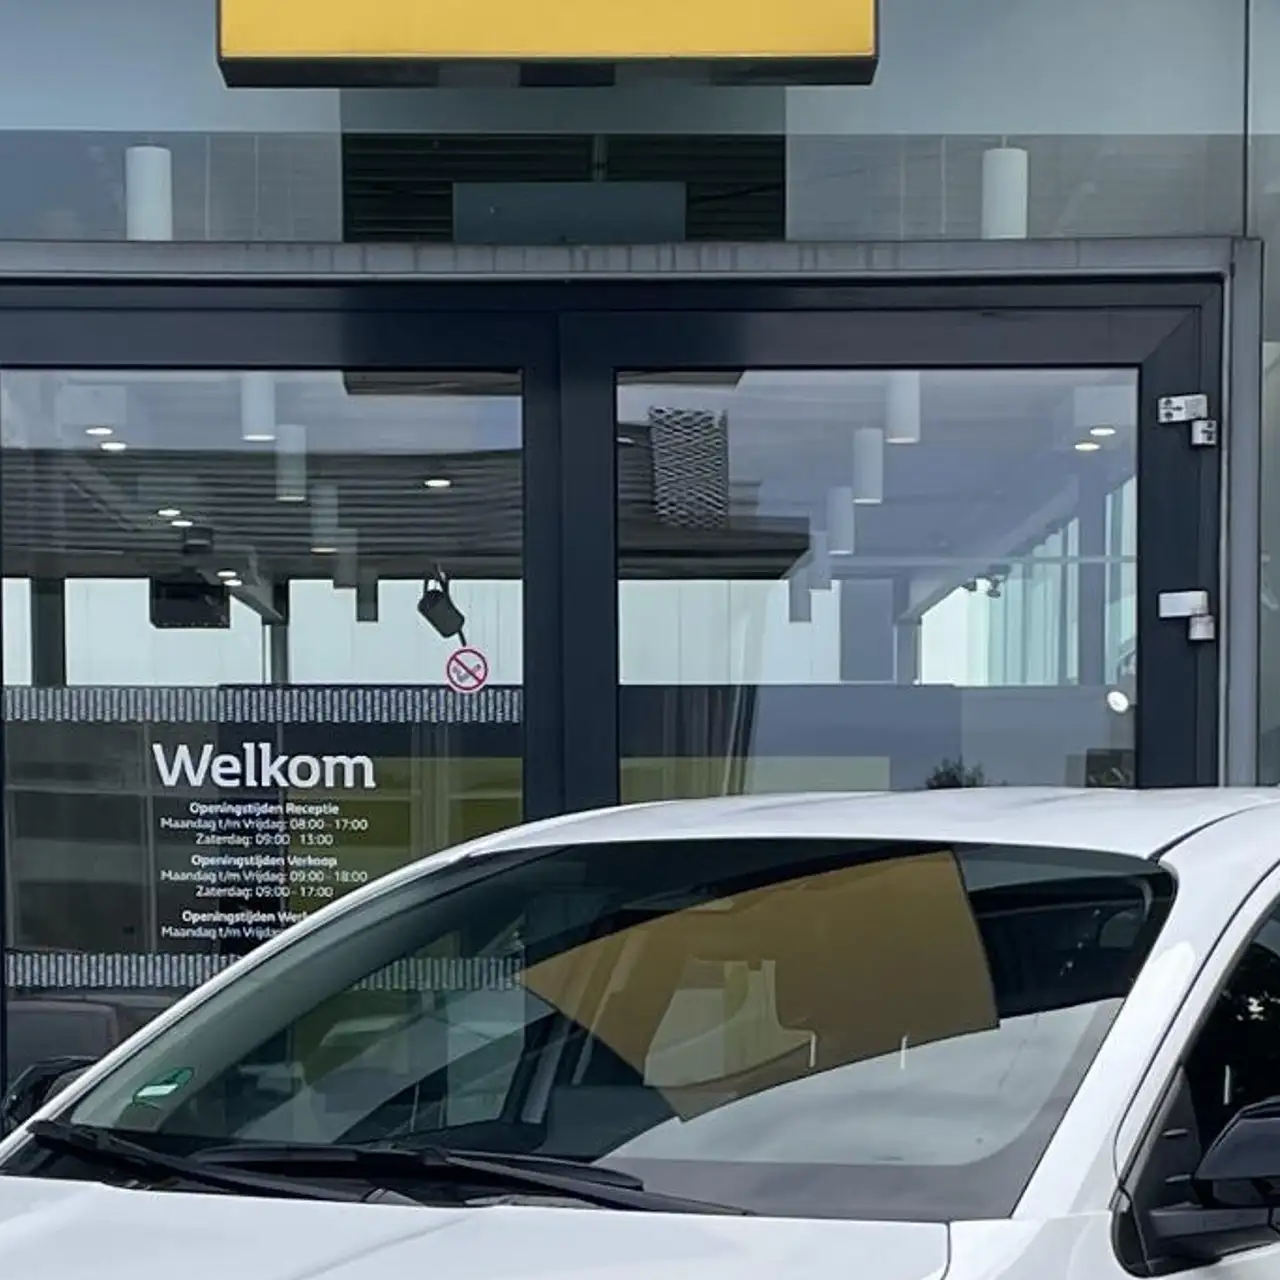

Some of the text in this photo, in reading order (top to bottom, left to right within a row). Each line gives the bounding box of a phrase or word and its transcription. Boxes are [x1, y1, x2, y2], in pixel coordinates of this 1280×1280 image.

[152, 742, 376, 788] Welkom
[189, 802, 339, 816] Openingstijden Receptie
[160, 818, 216, 832] Maandag
[218, 818, 241, 830] t/m
[335, 819, 368, 830] 17:00
[191, 855, 338, 868] Openingstijden Verkoop
[160, 870, 216, 883] Maandag
[218, 870, 241, 881] t/m
[182, 910, 275, 924] Openingstijden
[161, 925, 216, 940] Maandag
[218, 925, 241, 937] t/m
